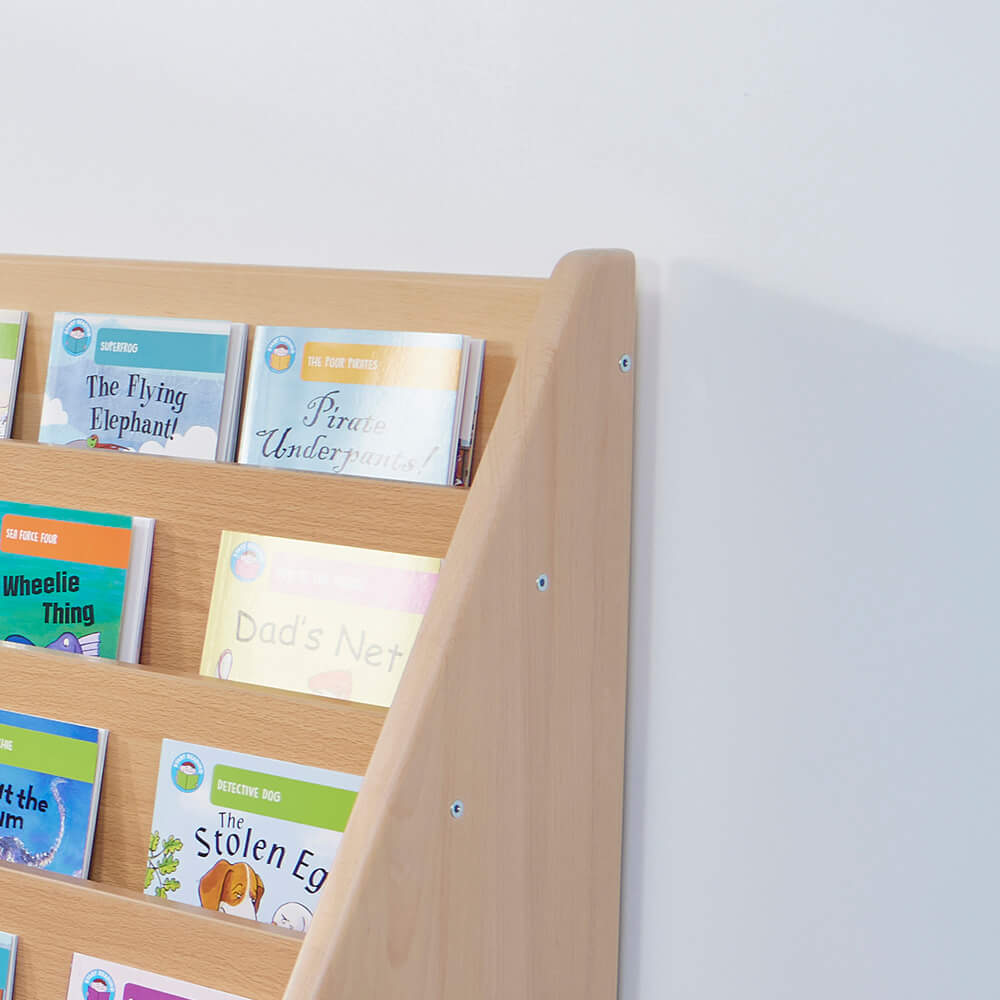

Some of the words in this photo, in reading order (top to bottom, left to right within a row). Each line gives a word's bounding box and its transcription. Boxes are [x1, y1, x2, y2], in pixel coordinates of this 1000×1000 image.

[100, 341, 138, 352] SUPERFROG
[308, 356, 321, 367] THE
[348, 357, 378, 369] PIRATES
[87, 375, 119, 398] The
[128, 374, 188, 413] Flying
[90, 407, 178, 440] Elephant!
[302, 390, 386, 434] Pirate
[256, 427, 439, 475] Underpants!
[6, 529, 18, 539] SEA
[19, 530, 39, 542] FORCE
[40, 533, 58, 544] FOUR
[3, 571, 80, 596] Wheelie
[43, 602, 94, 627] Thing
[236, 610, 323, 650] Dad's
[335, 624, 403, 672] Net
[17, 785, 48, 812] the
[217, 779, 259, 799] DETECTIVE
[262, 788, 281, 802] DOG
[218, 812, 244, 829] The
[195, 827, 285, 868] Stolen
